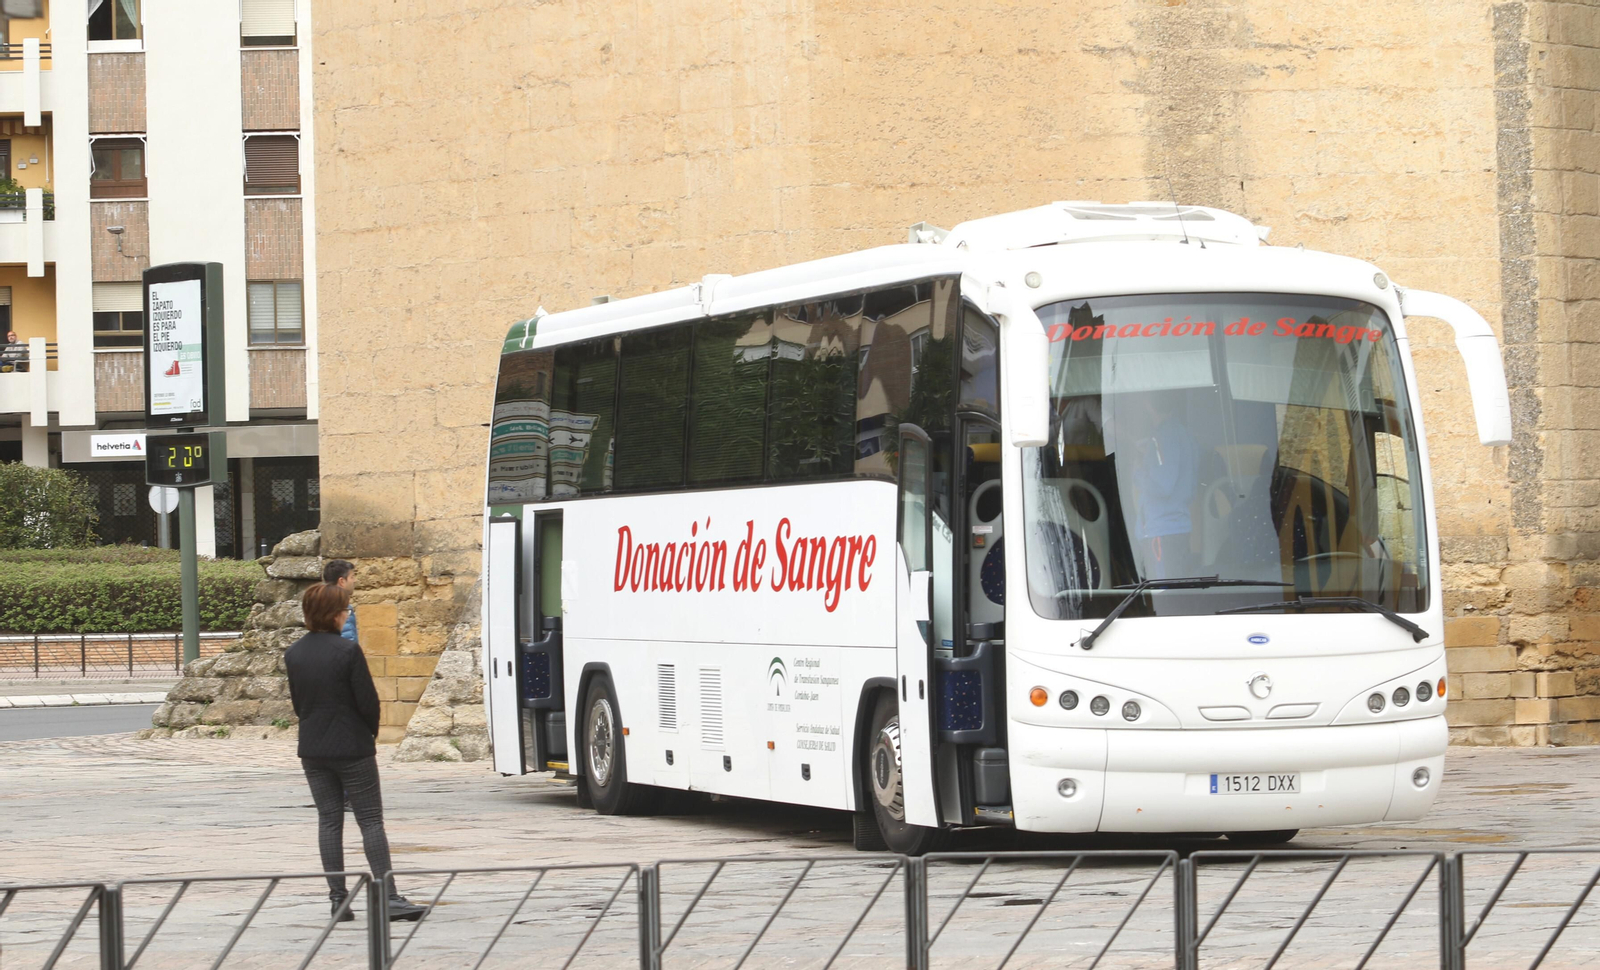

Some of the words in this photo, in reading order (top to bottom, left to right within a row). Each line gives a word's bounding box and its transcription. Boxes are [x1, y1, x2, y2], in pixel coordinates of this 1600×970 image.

[152, 291, 159, 300] EL
[152, 300, 174, 311] ZAPATO
[153, 310, 182, 321] IZQUIERDO
[153, 322, 160, 331] ES
[161, 321, 177, 331] PARA
[1047, 315, 1216, 343] Donación
[1224, 317, 1267, 336] de
[1273, 317, 1382, 345] Sangre
[153, 332, 160, 342] EL
[161, 331, 170, 341] PIE
[153, 341, 183, 352] IZQUIERDO
[96, 442, 131, 450] helvetia
[614, 516, 727, 593] Donación
[733, 519, 767, 593] de
[771, 517, 877, 613] Sangre
[1224, 775, 1261, 792] 1512
[1268, 774, 1296, 791] DXX
